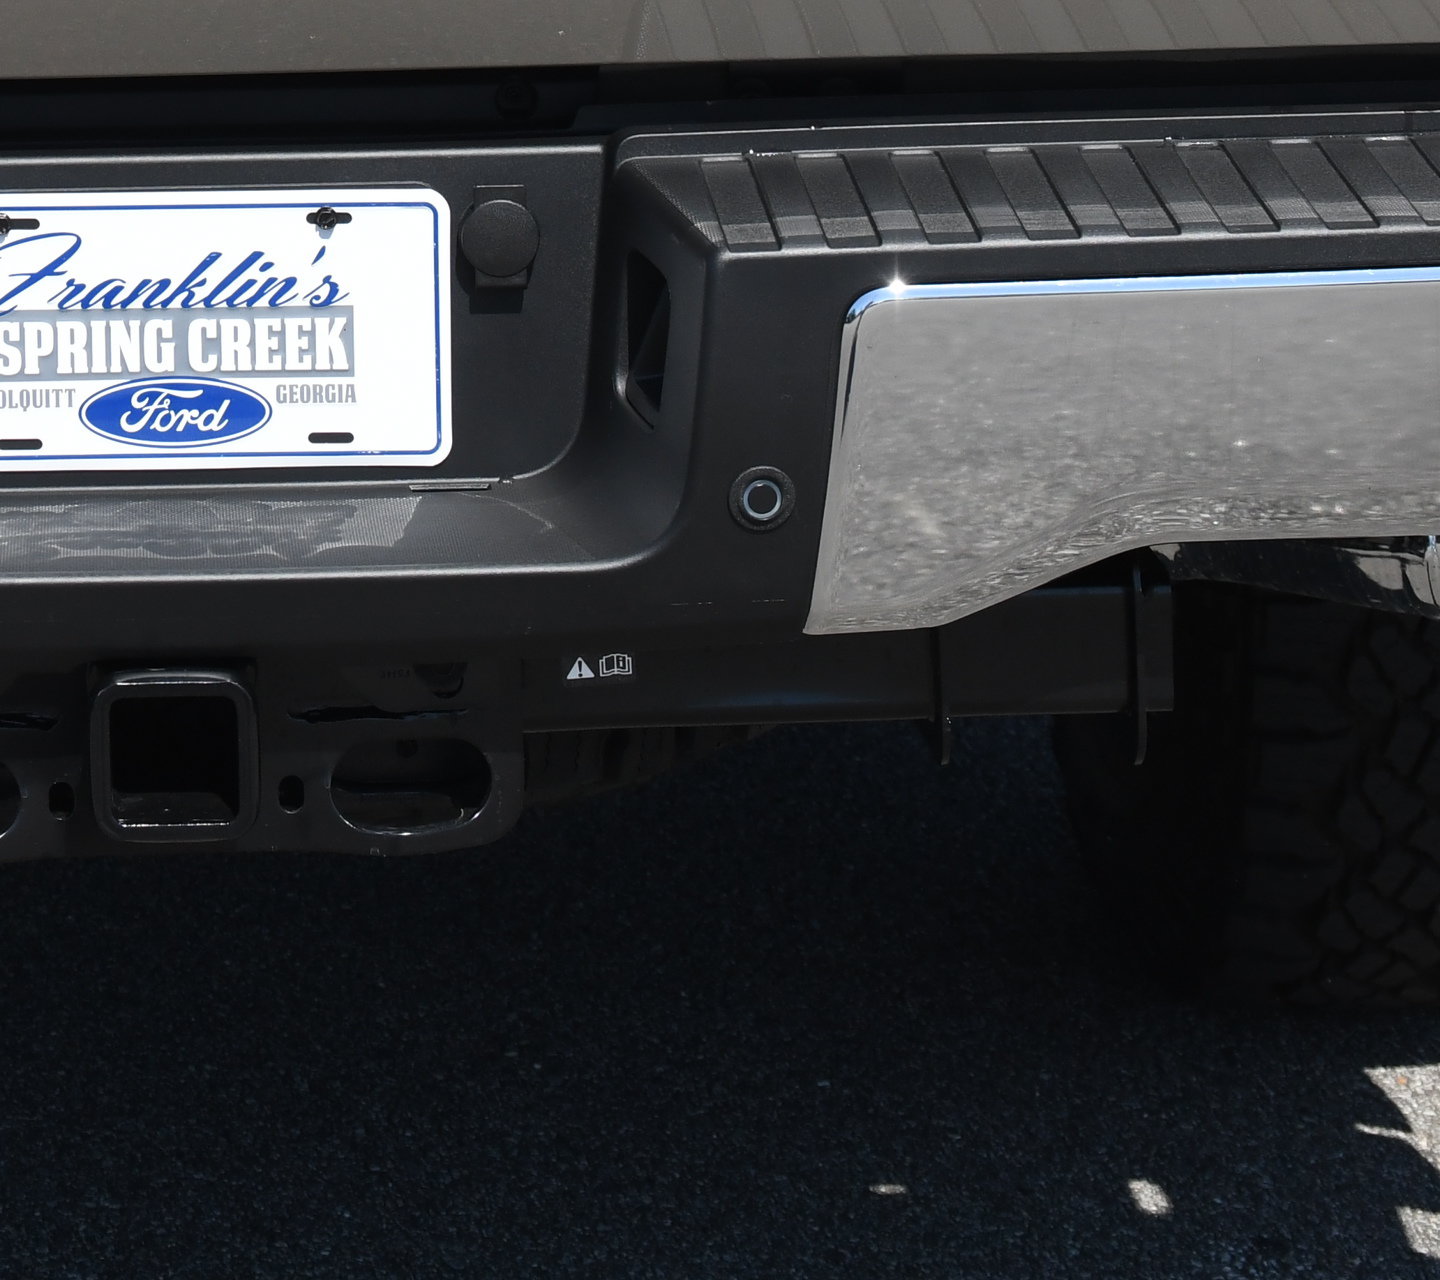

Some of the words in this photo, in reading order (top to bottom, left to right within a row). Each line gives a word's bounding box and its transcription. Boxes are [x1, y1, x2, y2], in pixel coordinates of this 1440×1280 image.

[187, 315, 352, 372] CREEK
[120, 387, 229, 434] Ford
[275, 382, 357, 404] GEORGIA
